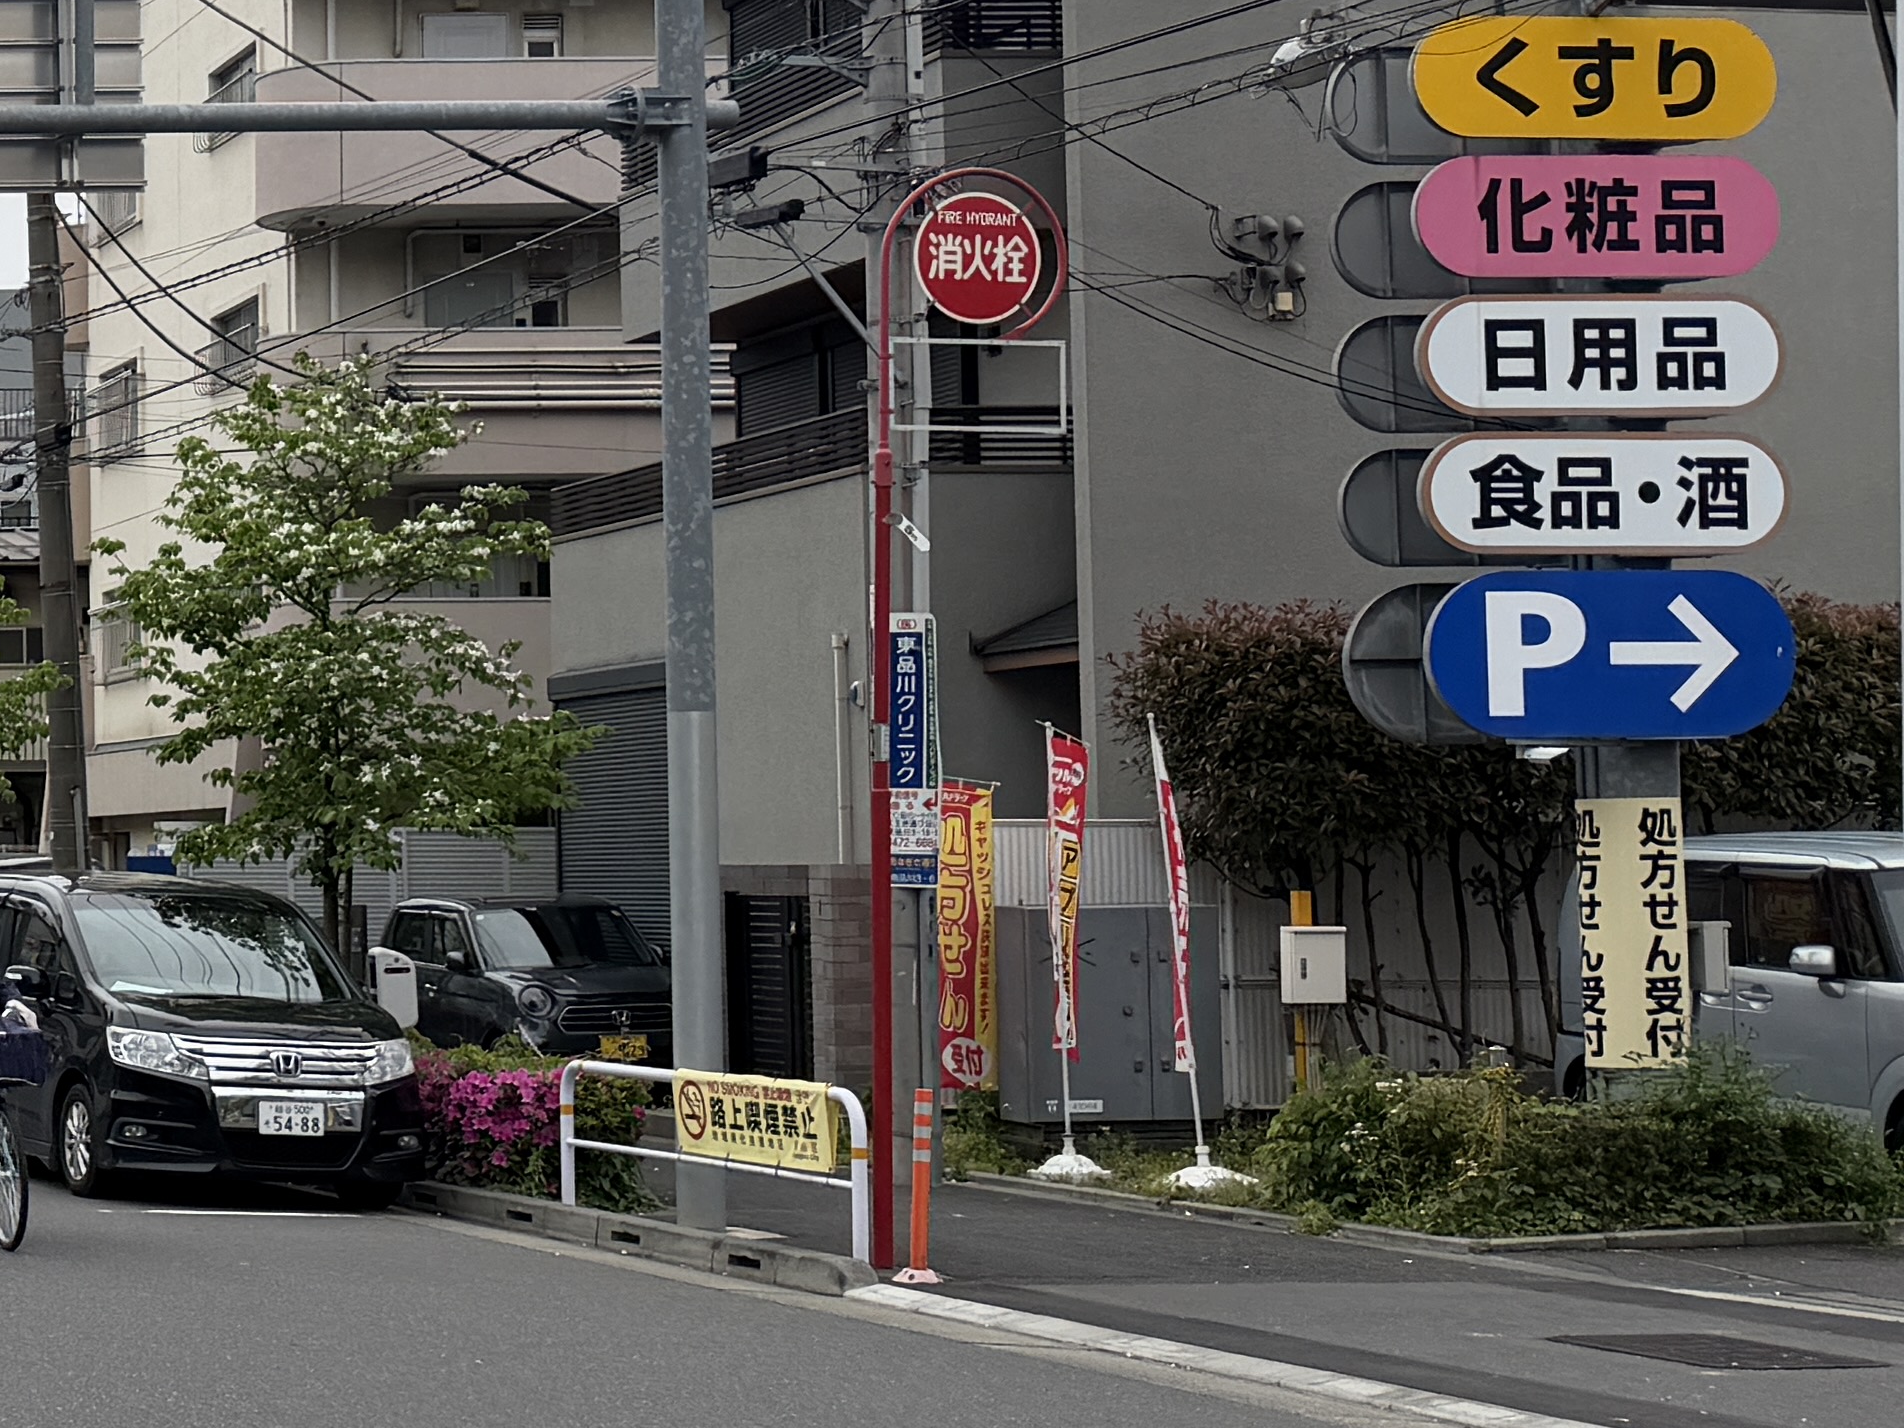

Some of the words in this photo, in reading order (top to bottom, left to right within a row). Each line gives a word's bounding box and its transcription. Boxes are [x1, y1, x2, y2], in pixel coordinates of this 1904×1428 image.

[1474, 37, 1717, 118] くすり
[937, 210, 962, 225] FIRE
[966, 211, 1016, 227] HYDRANT
[1477, 177, 1725, 255] 化粧品
[928, 232, 1029, 283] 消火栓
[1484, 316, 1727, 392] 日用品
[1469, 452, 1749, 531] 食品・酒
[1484, 590, 1587, 717] P
[895, 636, 917, 784] 東品川クリニック
[1638, 807, 1685, 1059] 処方せん受付
[951, 1043, 984, 1077] 受付
[273, 1115, 321, 1133] 54-88
[709, 1096, 818, 1140] 路上喫煙禁止
